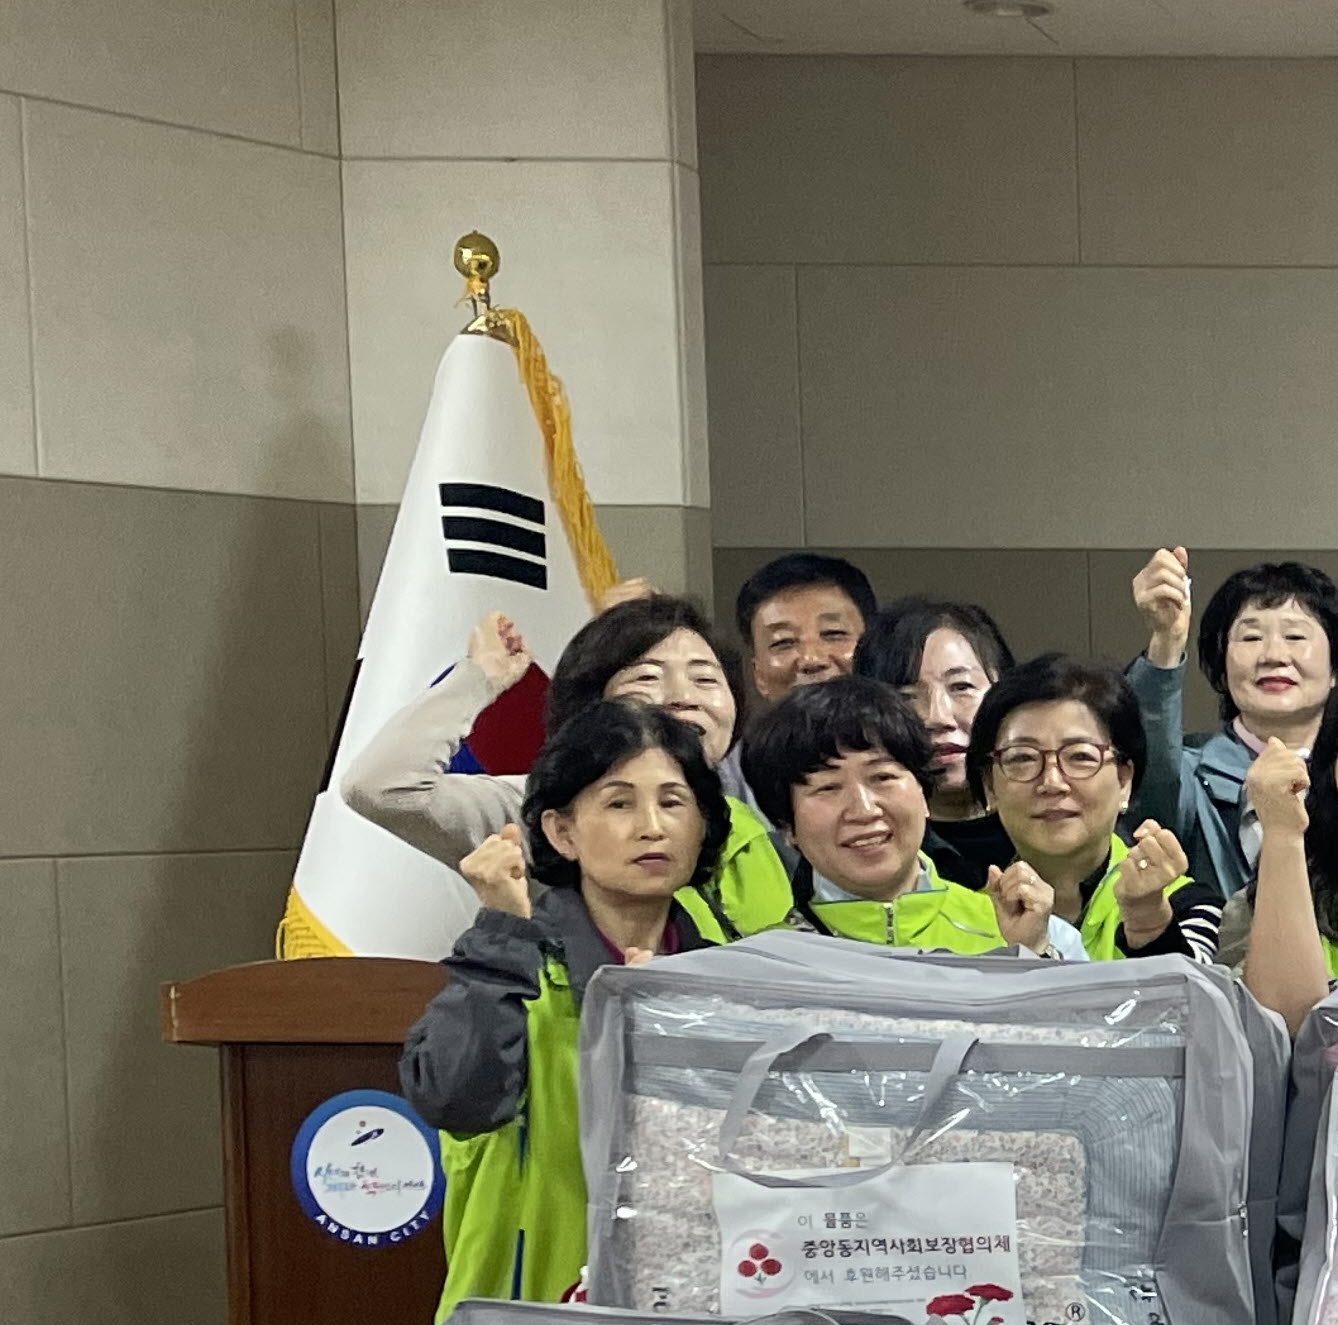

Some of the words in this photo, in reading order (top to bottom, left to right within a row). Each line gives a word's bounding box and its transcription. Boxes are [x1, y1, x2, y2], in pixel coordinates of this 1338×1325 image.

[316, 1213, 380, 1245] ANSAN
[390, 1210, 430, 1242] CITY
[798, 1215, 813, 1230] 이
[823, 1211, 869, 1230] 물품은
[801, 1234, 1012, 1259] 중앙동지역사회보장협의체
[804, 1268, 835, 1284] 에서
